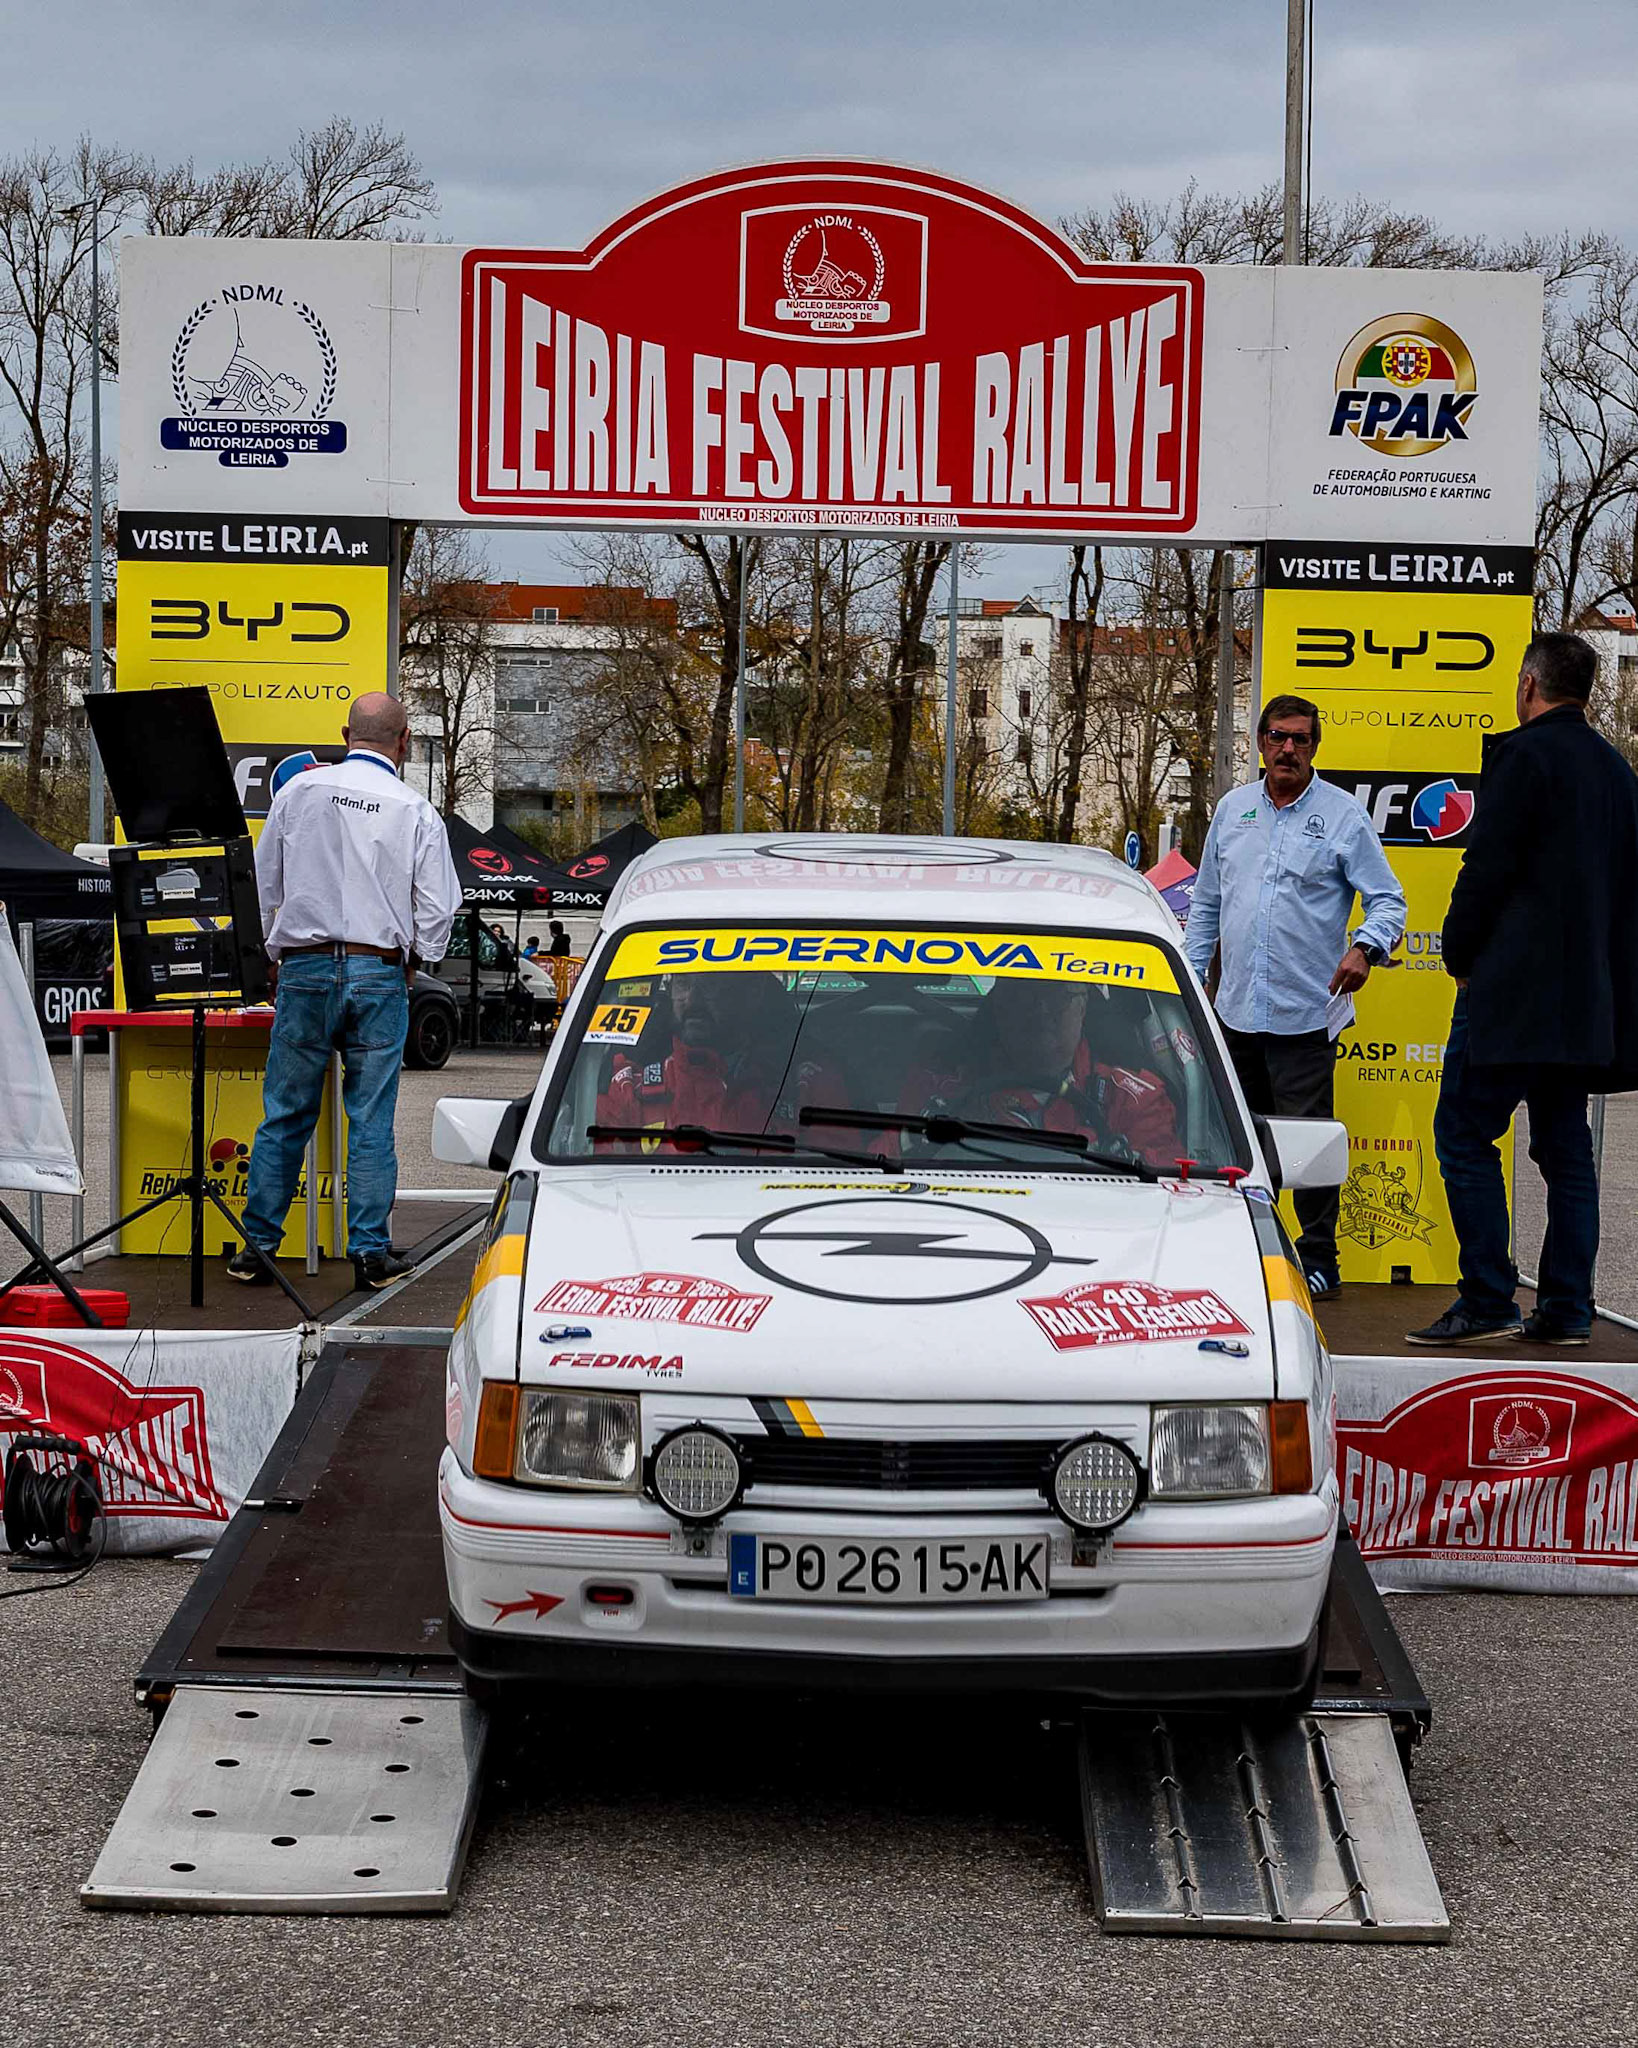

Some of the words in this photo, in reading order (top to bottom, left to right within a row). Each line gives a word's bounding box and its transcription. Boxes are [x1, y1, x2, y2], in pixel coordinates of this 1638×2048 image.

[814, 215, 853, 230] NDML
[222, 284, 284, 306] NDML
[825, 301, 880, 311] DESPORTOS
[793, 311, 858, 320] MOTORIZADOS
[860, 312, 872, 320] DE
[818, 321, 847, 329] LEIRIA
[488, 274, 671, 493] LEIRIA
[691, 353, 951, 503] FESTIVAL
[972, 292, 1178, 509] RALLYE
[1329, 390, 1479, 440] FPAK
[177, 418, 237, 433] NÚCLEO
[241, 422, 330, 435] DESPORTOS
[189, 436, 295, 450] MOTORIZADOS
[299, 438, 318, 450] DE
[230, 453, 277, 465] LEIRIA
[1328, 468, 1396, 483] FEDERAÇÃO
[1399, 472, 1476, 484] PORTUGUESA
[1313, 484, 1328, 495] DE
[1331, 485, 1427, 497] AUTOMOBILISMO
[1430, 487, 1437, 498] E
[1440, 488, 1491, 499] KARTING
[699, 508, 746, 521] NUCLEO
[748, 509, 816, 524] DESPORTOS
[818, 511, 901, 525] MOTORIZADOS
[903, 512, 919, 526] DE
[921, 513, 959, 527] LEIRIA
[132, 529, 214, 551] VISITE
[1280, 558, 1361, 580] VISITE
[151, 599, 351, 642] BYD
[1296, 627, 1495, 671] BYD
[331, 795, 381, 814] ndml.pt
[463, 888, 516, 901] 24MX
[552, 891, 603, 905] 24MX
[656, 936, 1045, 970] SUPERNOVA
[1049, 950, 1146, 980] Team
[599, 1007, 640, 1033] 45
[1358, 1067, 1396, 1081] RENT
[1400, 1069, 1410, 1082] A
[1374, 1138, 1413, 1152] GORDO
[1363, 1211, 1408, 1234] CERVEJARIA
[646, 1279, 684, 1294] 45
[1102, 1288, 1148, 1307] 40
[544, 1282, 600, 1314] LEIRIA
[602, 1294, 688, 1320] FESTIVAL
[685, 1298, 762, 1331] RALLYE
[1031, 1303, 1121, 1337] RALLY
[1119, 1295, 1234, 1329] LEGENDS
[548, 1353, 684, 1370] FEDIMA
[646, 1370, 683, 1379] TYRES
[1511, 1401, 1534, 1409] NDML
[1342, 1445, 1426, 1550] EIRIA
[1428, 1474, 1573, 1549] FESTIVAL
[1458, 1552, 1496, 1562] DESPORTOS
[1497, 1554, 1544, 1563] MOTORIZADOS
[1545, 1555, 1554, 1563] DE
[1555, 1556, 1576, 1564] LEIRIA
[737, 1571, 750, 1586] E
